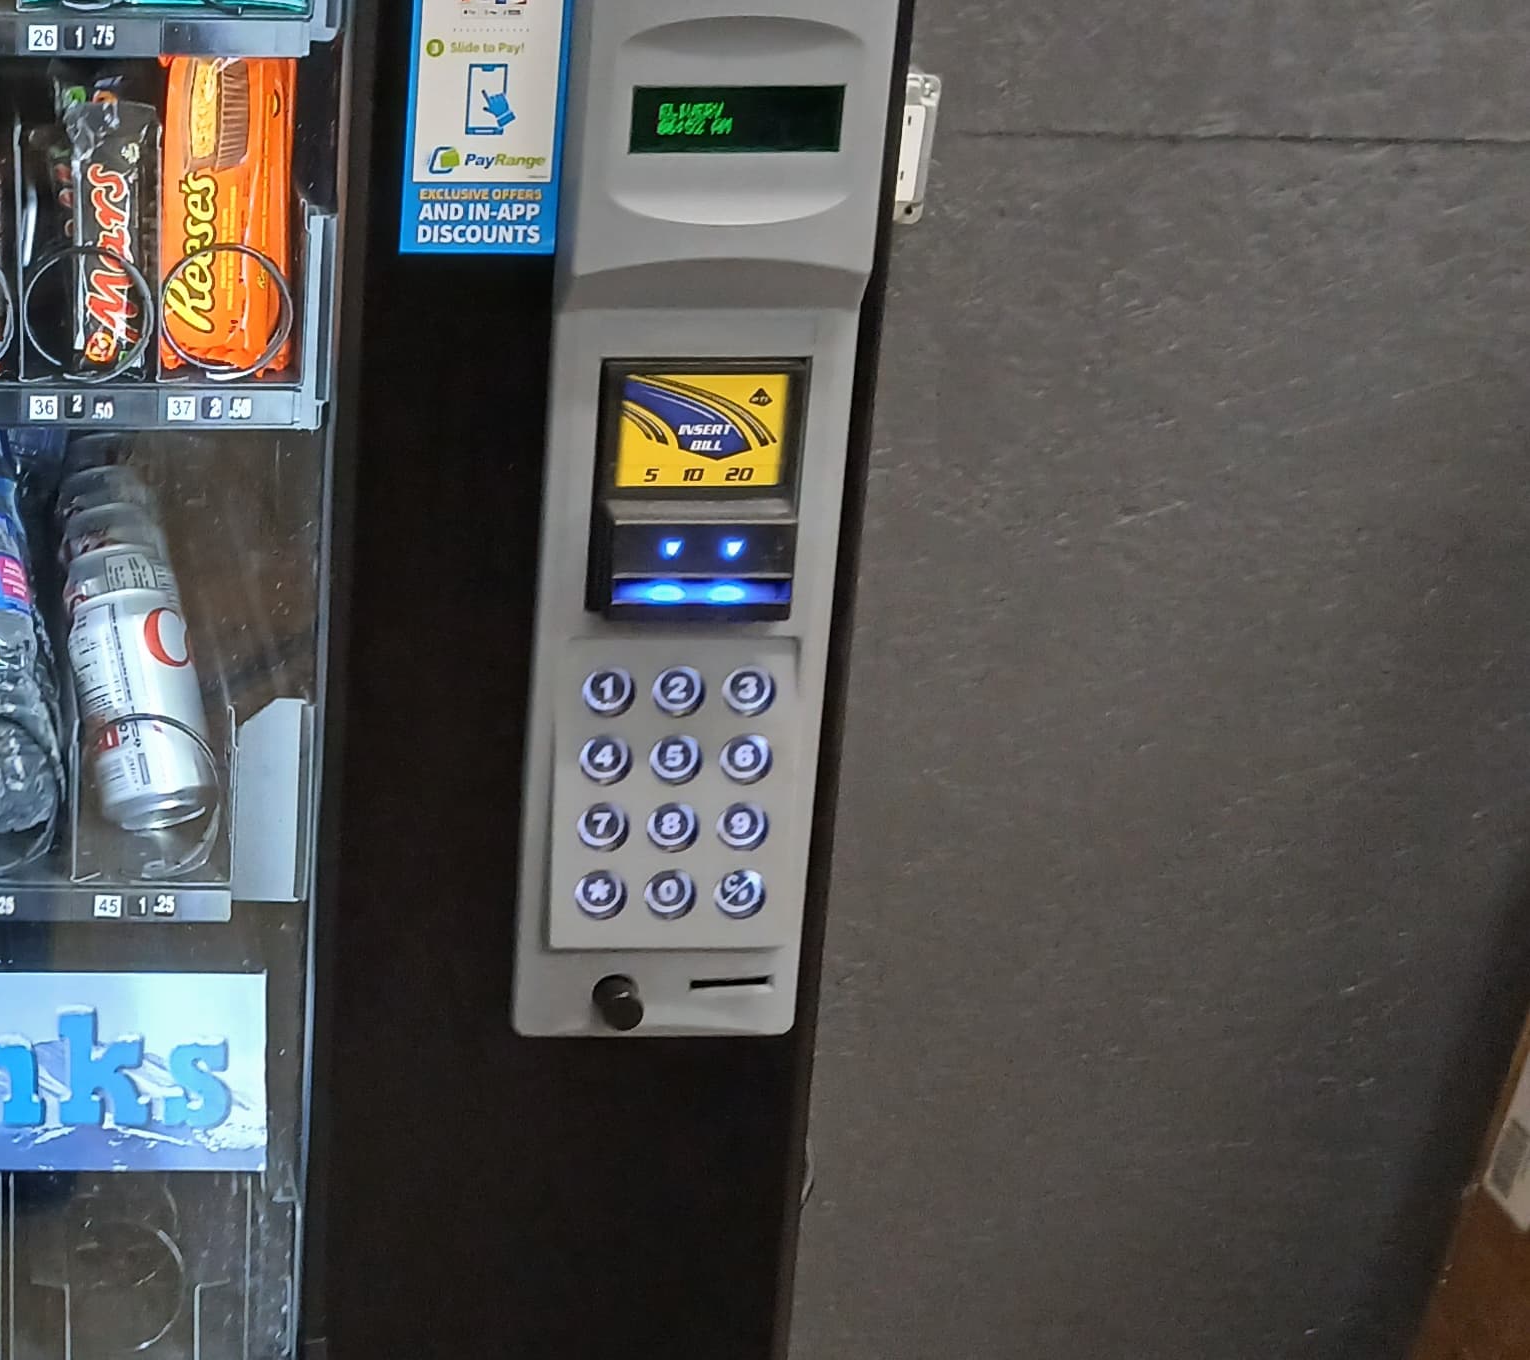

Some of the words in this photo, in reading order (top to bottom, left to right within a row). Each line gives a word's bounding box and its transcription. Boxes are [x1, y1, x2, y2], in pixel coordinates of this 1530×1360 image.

[33, 29, 54, 47] 26
[450, 41, 480, 54] Slide
[482, 42, 497, 54] to
[497, 42, 525, 57] Pay!
[464, 152, 547, 170] PayRange
[419, 188, 490, 201] EXCLUSIVE
[491, 188, 543, 201] OFFERS
[419, 204, 465, 221] AND
[467, 203, 541, 221] IN-APP
[417, 225, 541, 244] DISCOUNTS
[87, 163, 138, 344] Mars
[163, 170, 217, 334] Reese's
[34, 399, 54, 415] 36
[172, 400, 191, 416] 37
[677, 424, 733, 436] INSERT
[689, 440, 724, 452] BILL
[643, 468, 660, 483] 5
[682, 468, 705, 482] 10
[724, 467, 755, 482] 20
[598, 676, 616, 700] 1
[667, 676, 689, 700] 2
[737, 676, 759, 700] 3
[593, 745, 615, 767] 4
[665, 745, 685, 767] 5
[734, 744, 754, 765] 6
[592, 812, 613, 835] 7
[659, 812, 680, 834] 8
[729, 812, 750, 833] 9
[660, 878, 676, 901] 0
[99, 898, 118, 914] 45
